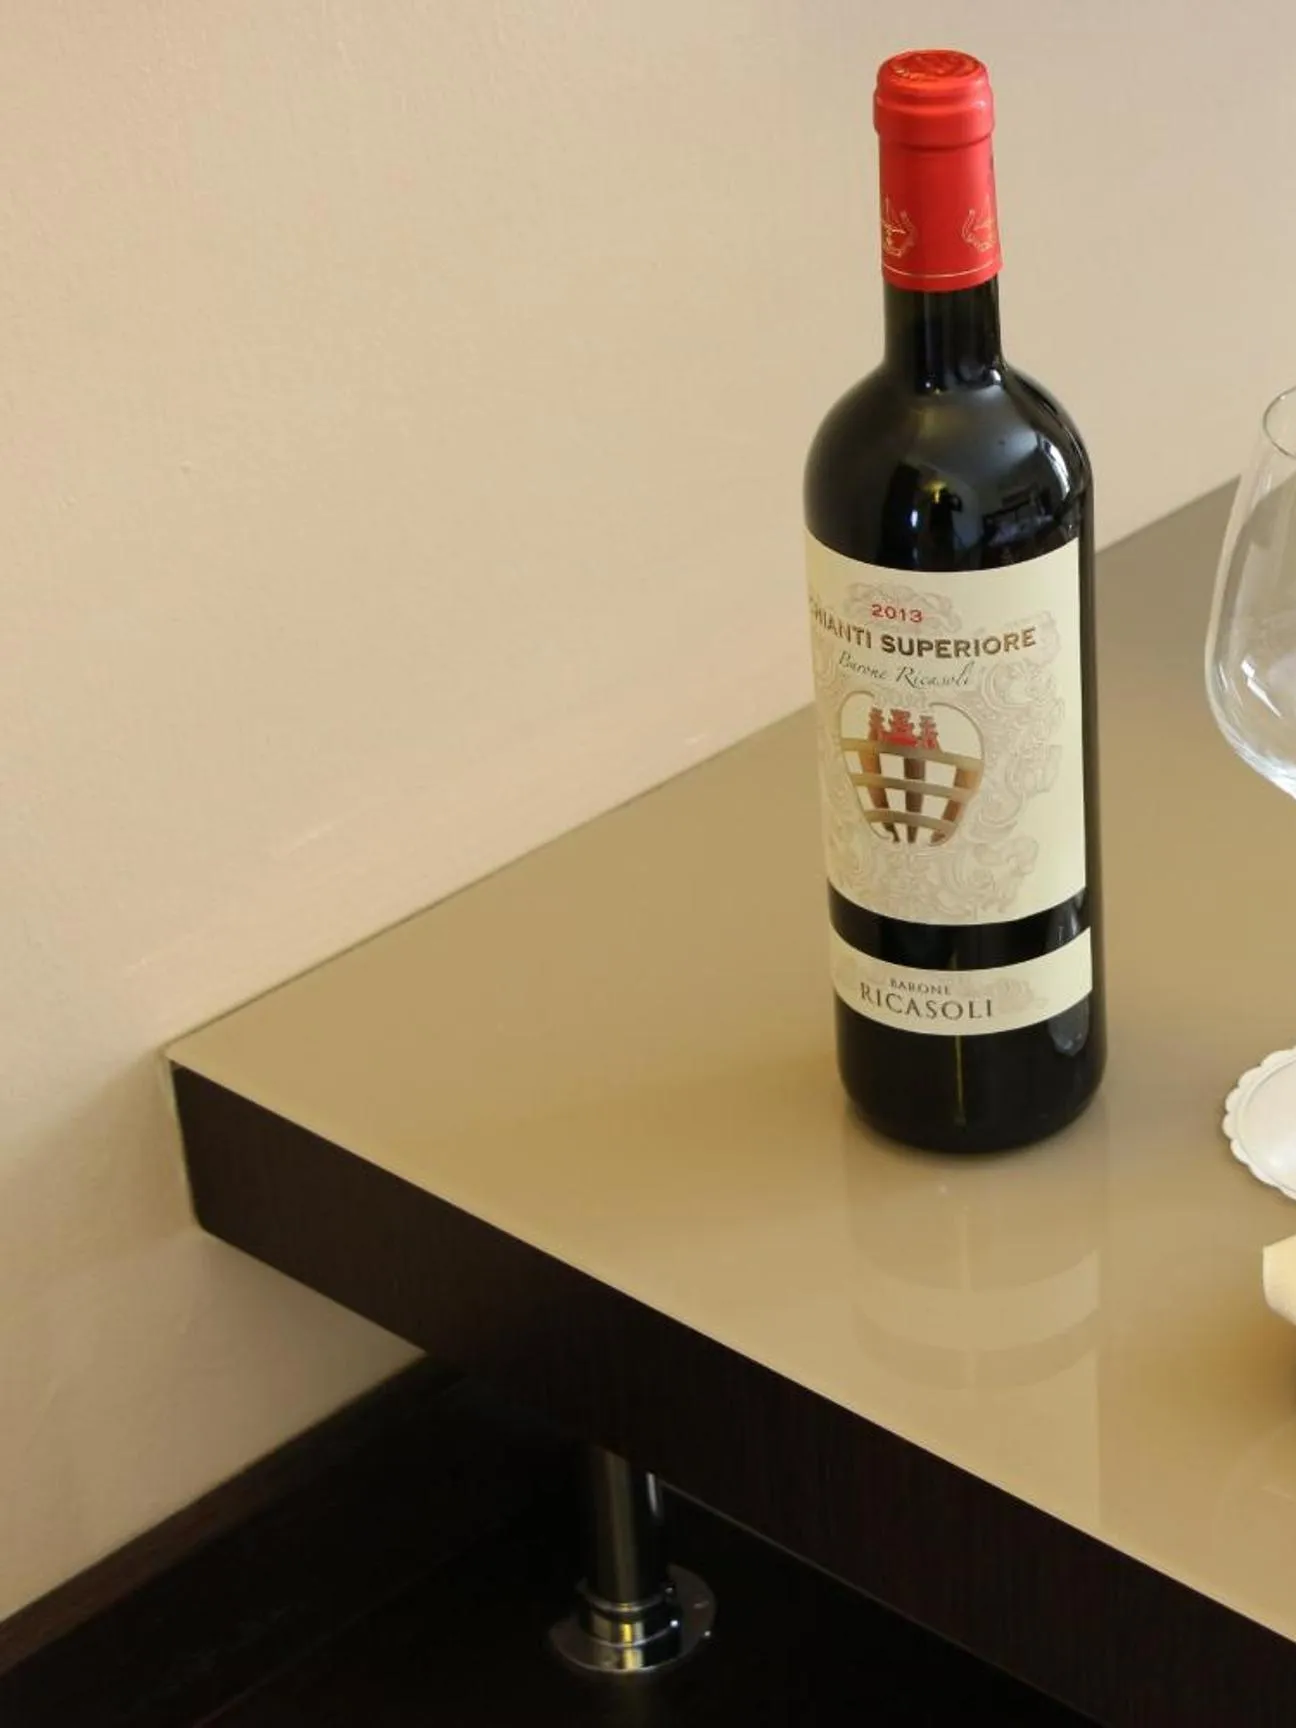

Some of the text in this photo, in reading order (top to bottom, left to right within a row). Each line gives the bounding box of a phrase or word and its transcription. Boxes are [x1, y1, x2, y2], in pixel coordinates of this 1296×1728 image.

[871, 603, 923, 623] 2013
[881, 626, 1037, 659] SUPERIORE
[838, 650, 974, 689] Barone Ricasoli
[860, 981, 992, 1020] RICASOLI
[890, 978, 951, 995] BARONE
